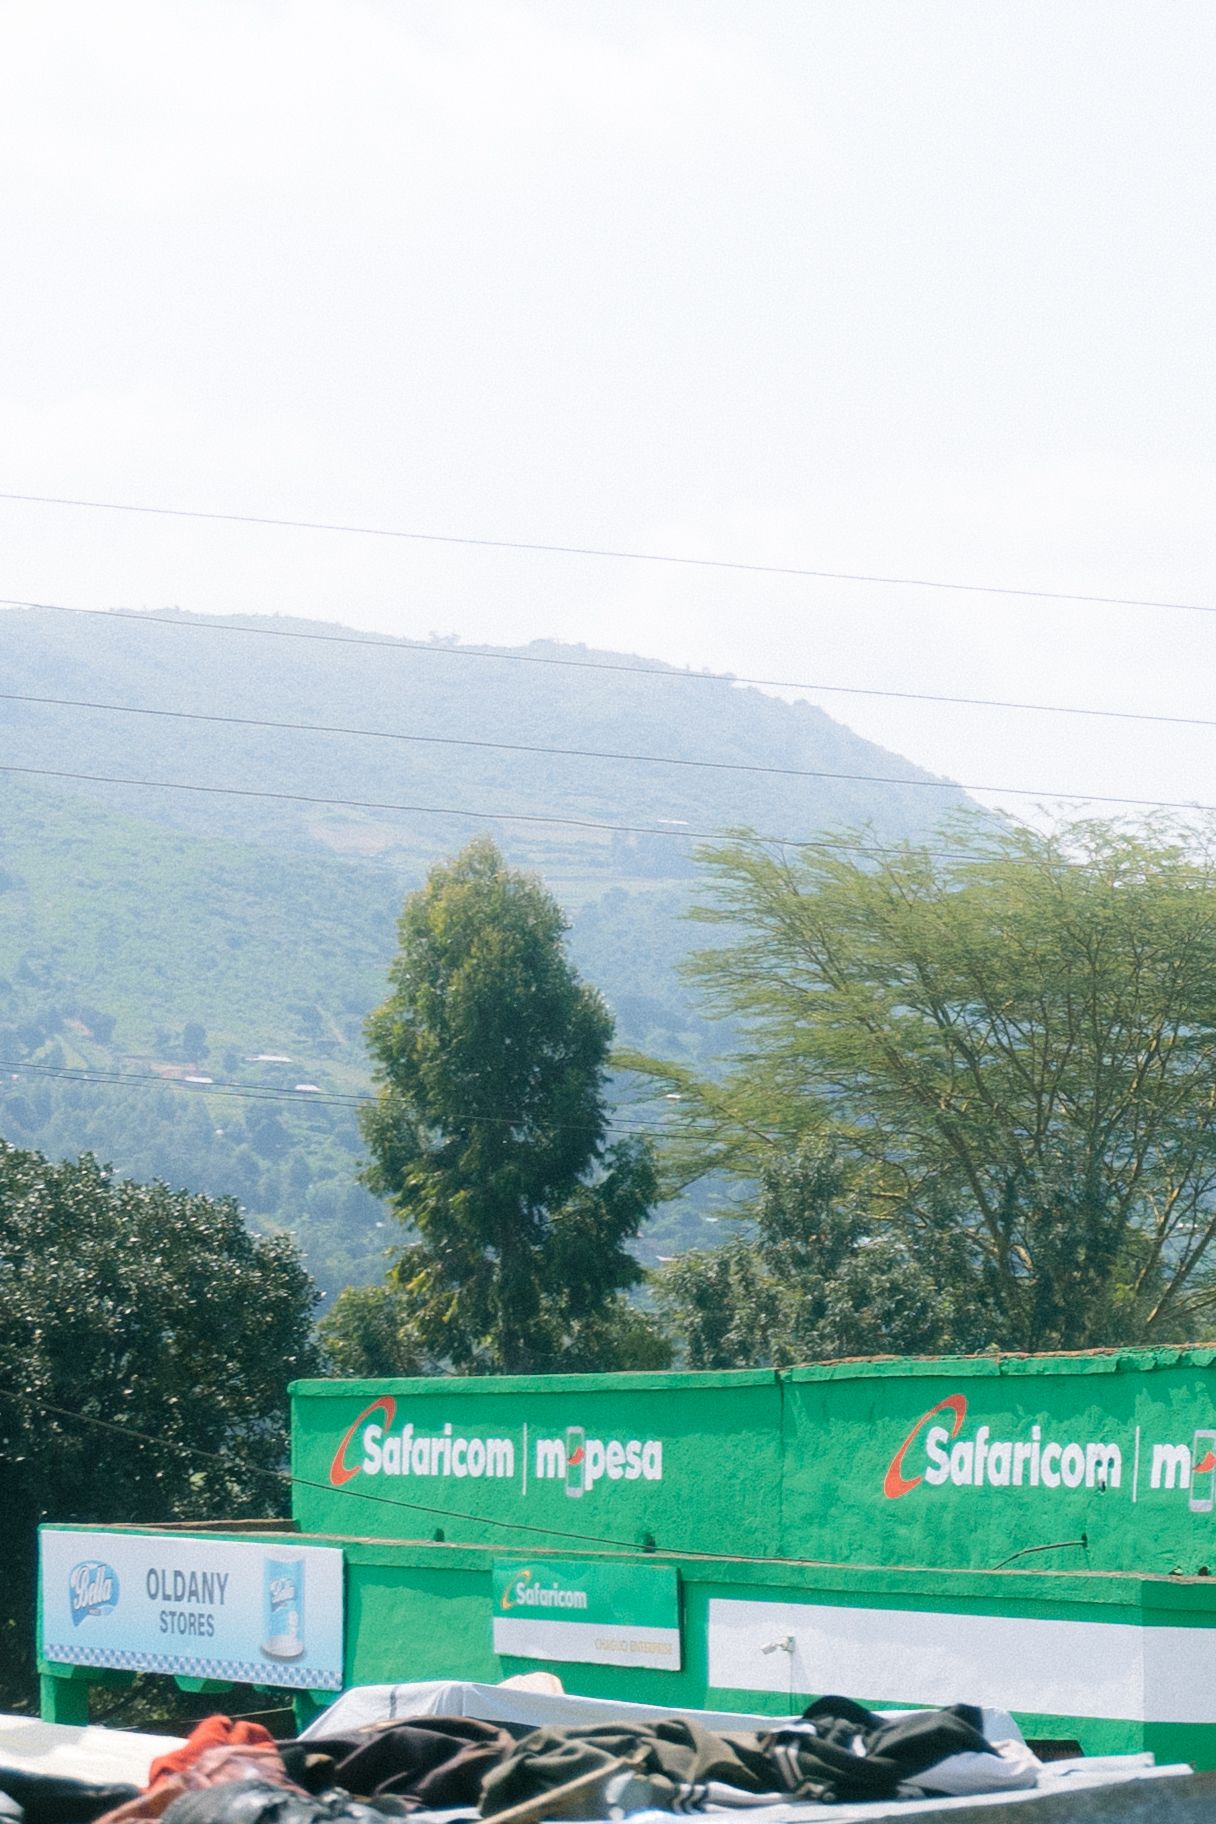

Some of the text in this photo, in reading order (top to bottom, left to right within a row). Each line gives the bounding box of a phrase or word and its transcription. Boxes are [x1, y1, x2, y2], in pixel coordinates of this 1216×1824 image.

[362, 1422, 514, 1479] Safaricom
[925, 1426, 1121, 1490] Safaricom
[146, 1567, 229, 1606] OLDANY
[515, 1582, 588, 1609] Safaricom
[159, 1610, 215, 1637] STORES
